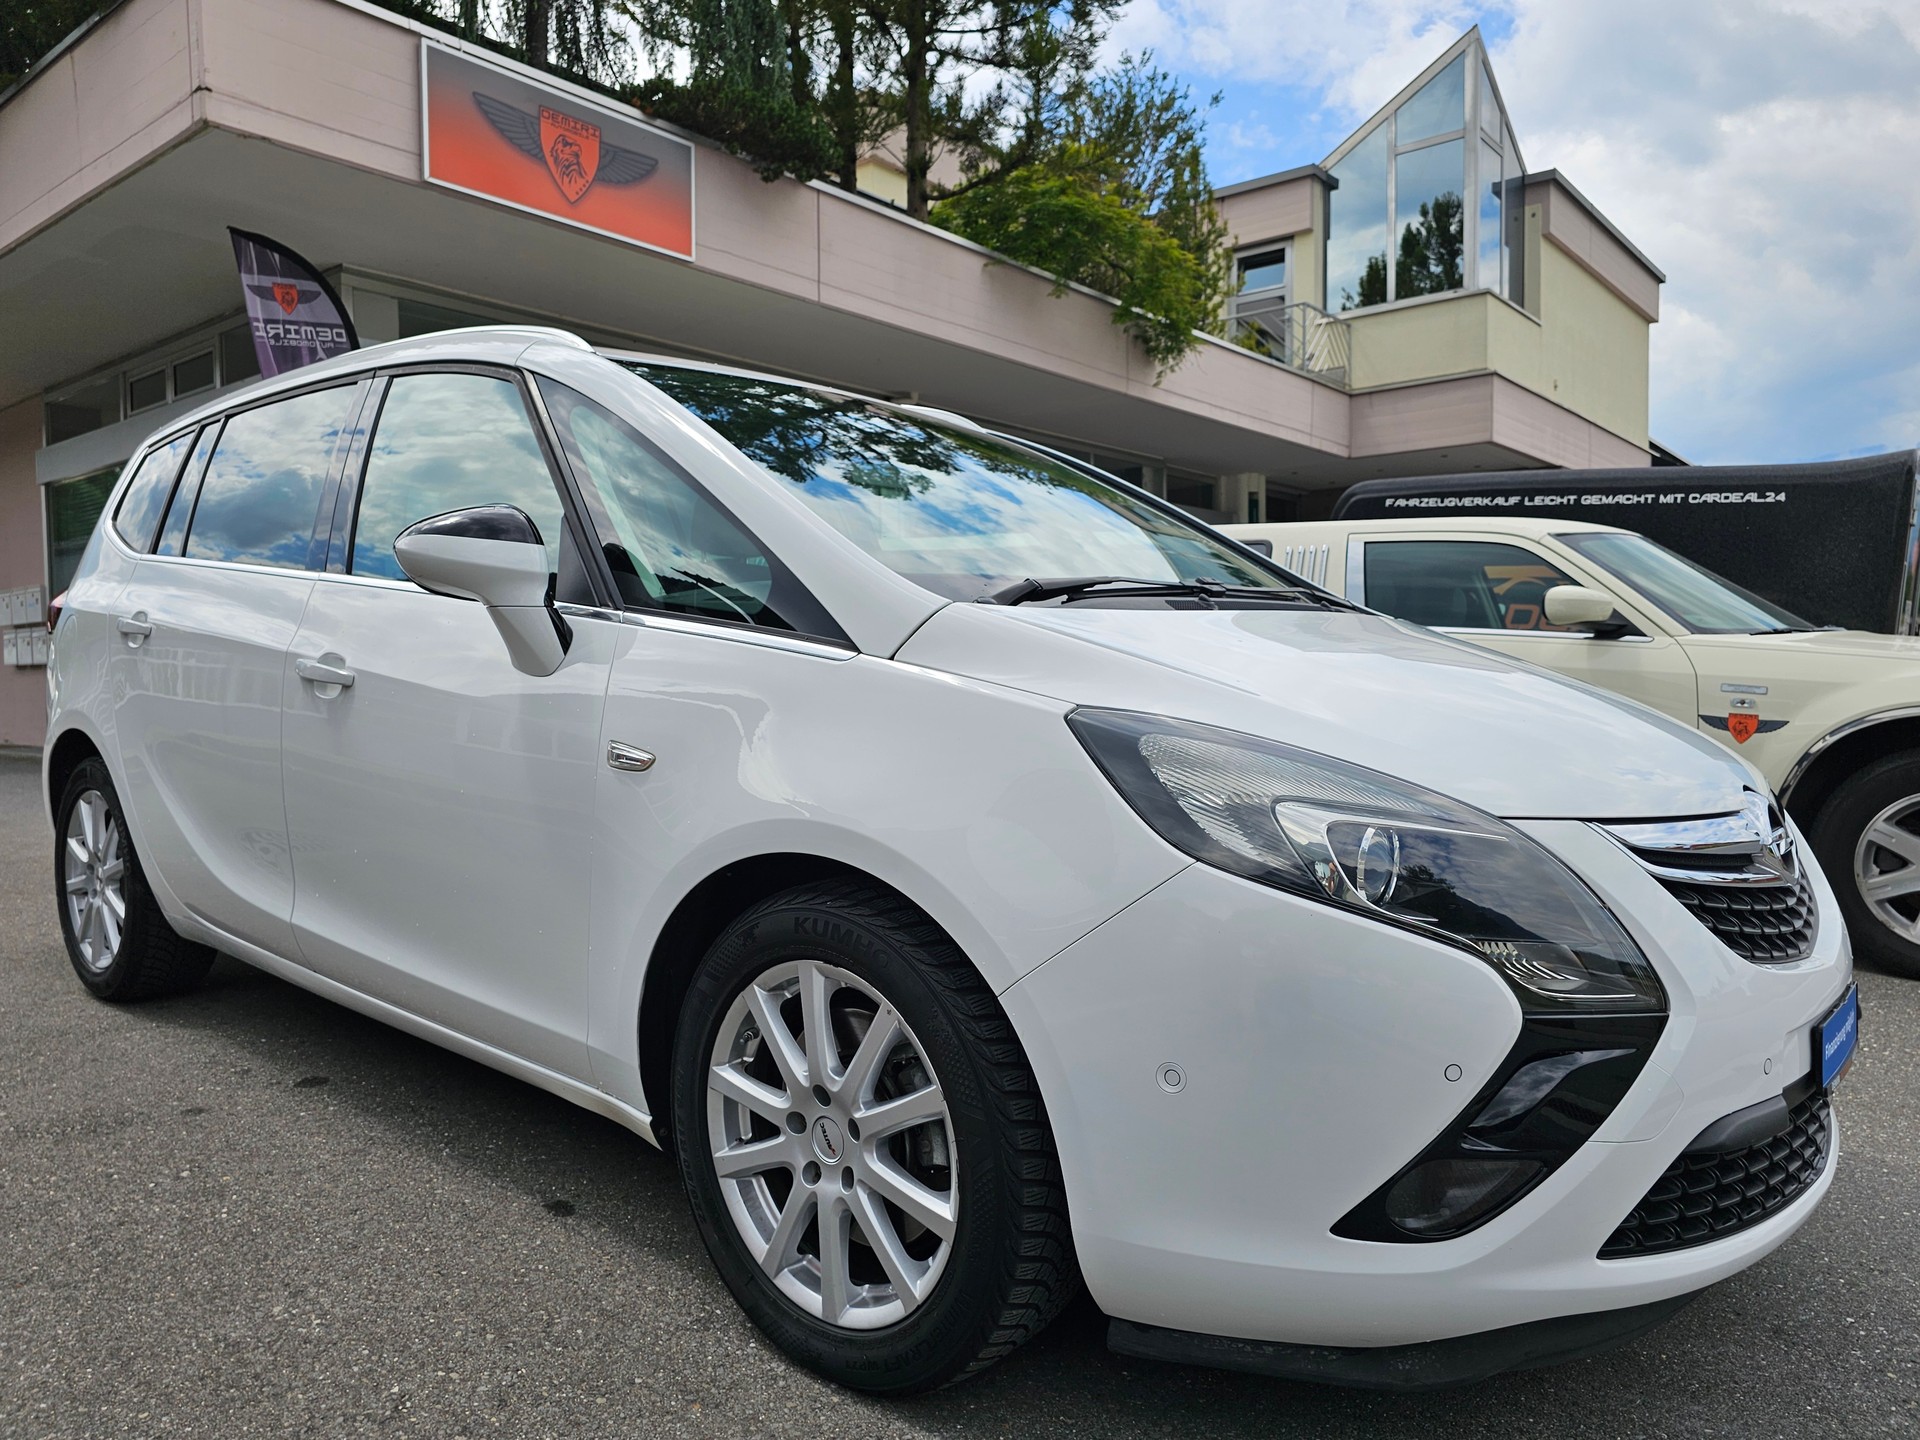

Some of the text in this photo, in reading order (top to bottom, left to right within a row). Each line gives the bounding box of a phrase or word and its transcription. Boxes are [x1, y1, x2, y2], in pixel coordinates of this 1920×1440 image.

[541, 109, 599, 139] DEMIRI
[1385, 492, 1786, 507] FAHRZEUGVERKAUF LEICHT GEMACHT MIT CARDEAL24
[793, 915, 889, 969] KUMHO
